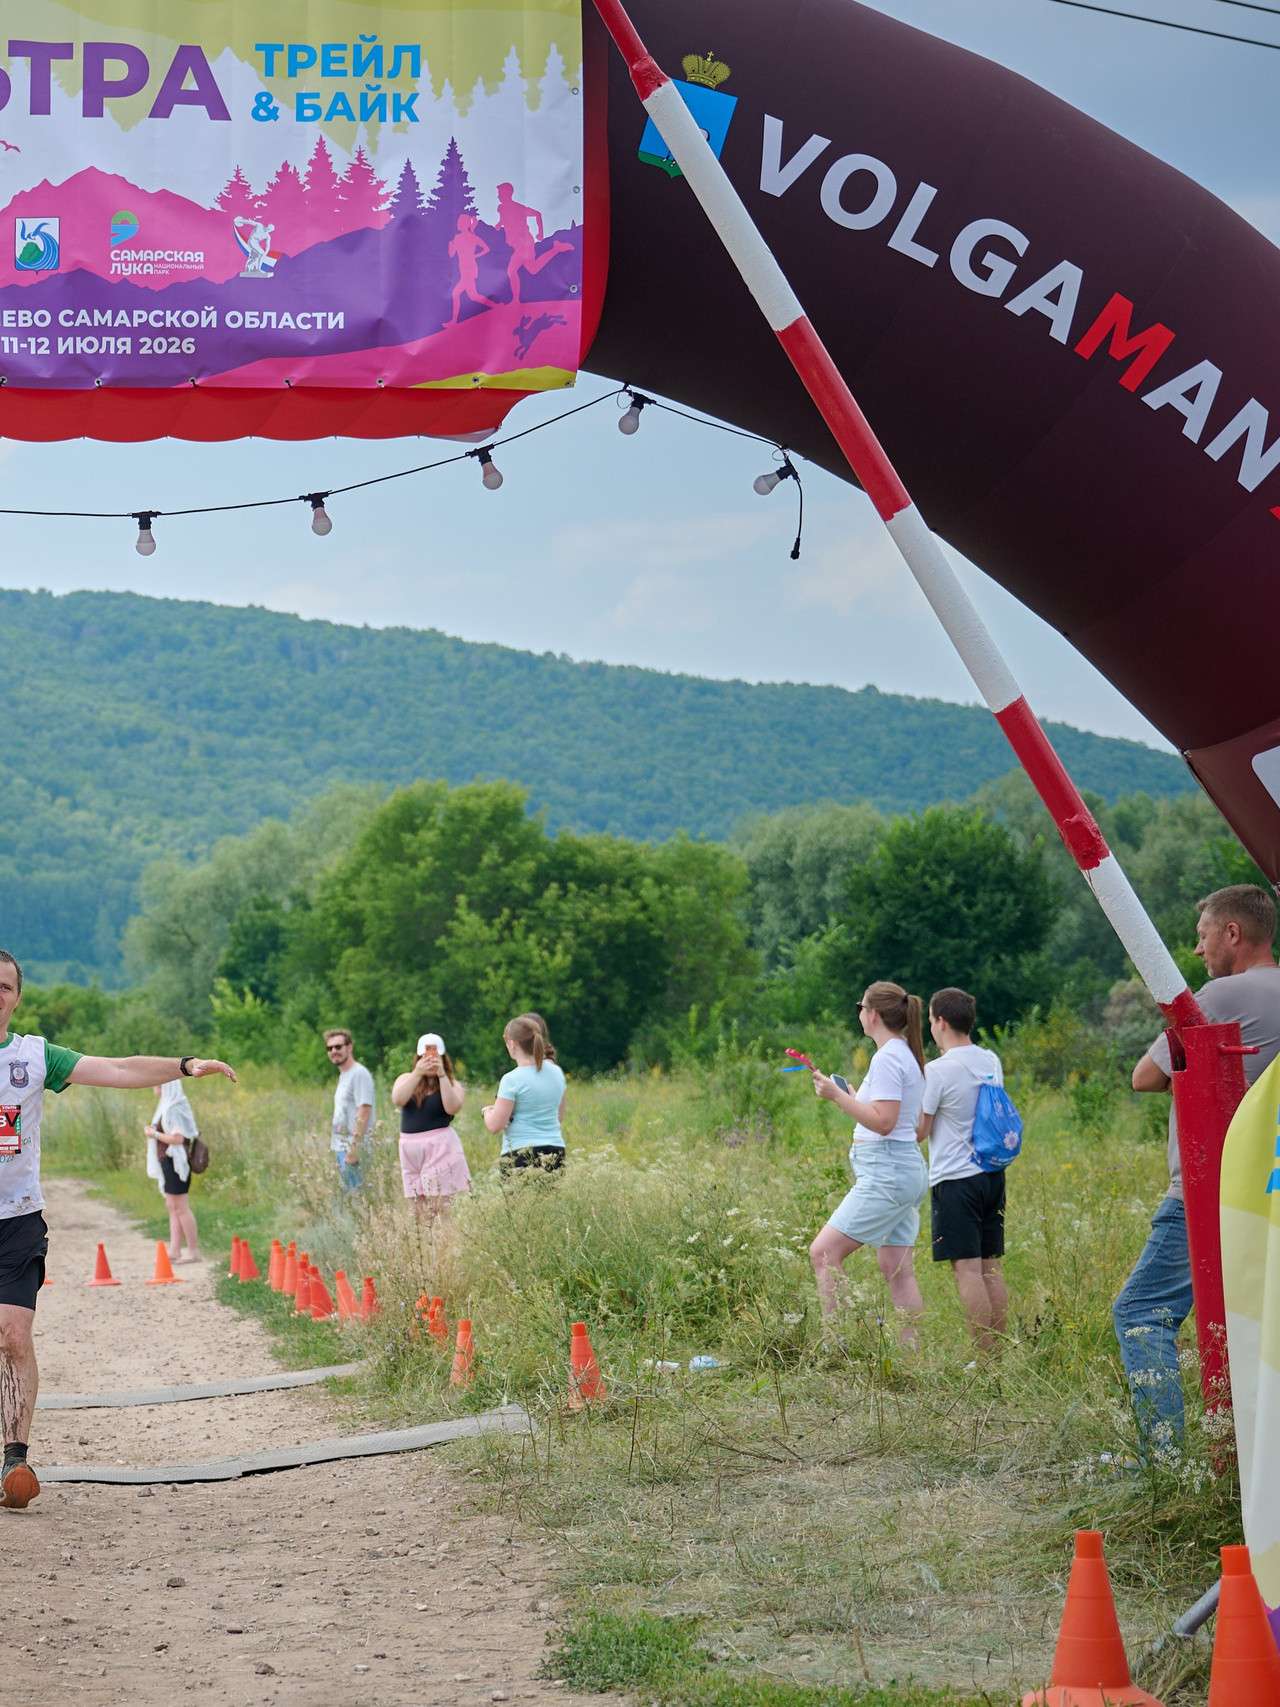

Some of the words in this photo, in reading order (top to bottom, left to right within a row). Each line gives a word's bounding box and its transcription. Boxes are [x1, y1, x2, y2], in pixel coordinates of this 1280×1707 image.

[255, 34, 421, 79] ТРЕЙЛ
[250, 92, 280, 122] &
[295, 85, 421, 123] БАЙК
[110, 250, 204, 263] САМАРСКАЯ
[110, 263, 153, 276] ЛУКА
[760, 113, 1280, 493] VOLGAMAN
[58, 305, 218, 329] САМАРСКОЙ
[224, 310, 345, 330] ОБЛАСТИ
[0, 336, 50, 354] 11-12
[57, 336, 132, 355] ИЮЛЯ
[139, 337, 196, 355] 2026
